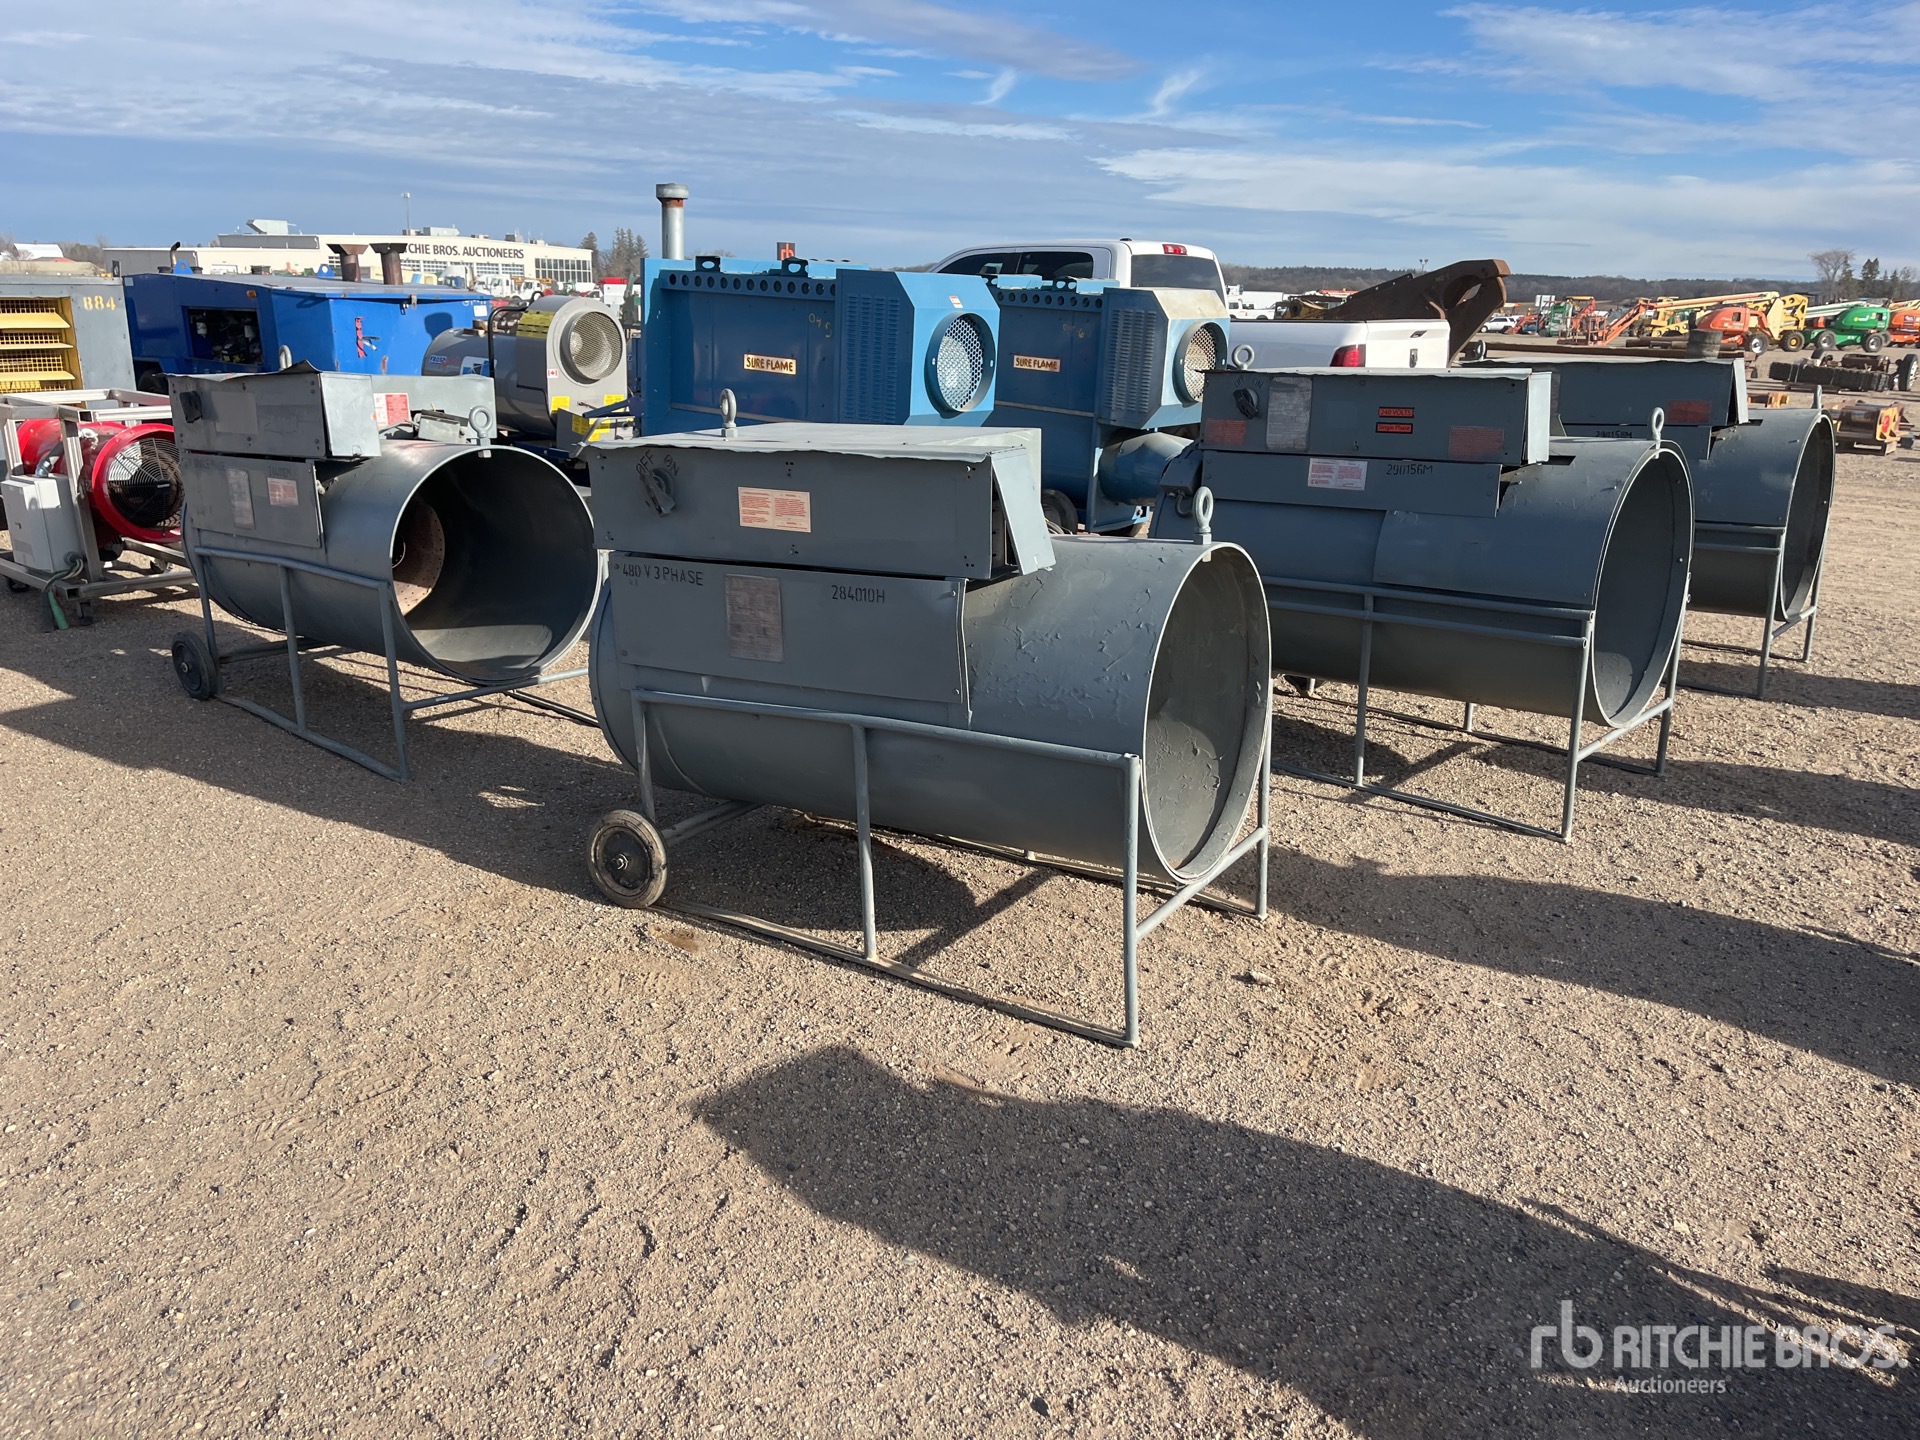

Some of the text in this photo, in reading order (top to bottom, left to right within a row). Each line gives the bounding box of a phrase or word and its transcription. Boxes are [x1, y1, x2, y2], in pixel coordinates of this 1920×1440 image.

[433, 245, 461, 256] BROS.
[463, 246, 525, 259] AUCTIONEERS
[83, 295, 116, 311] 884
[746, 356, 794, 372] SURE FLAME
[1015, 357, 1058, 371] SURE FLAME
[1392, 409, 1411, 417] VOLTS
[635, 449, 680, 477] OFF ON
[622, 563, 642, 578] 480
[644, 564, 651, 579] V
[662, 567, 703, 586] PHASE
[831, 584, 886, 604] 284010H
